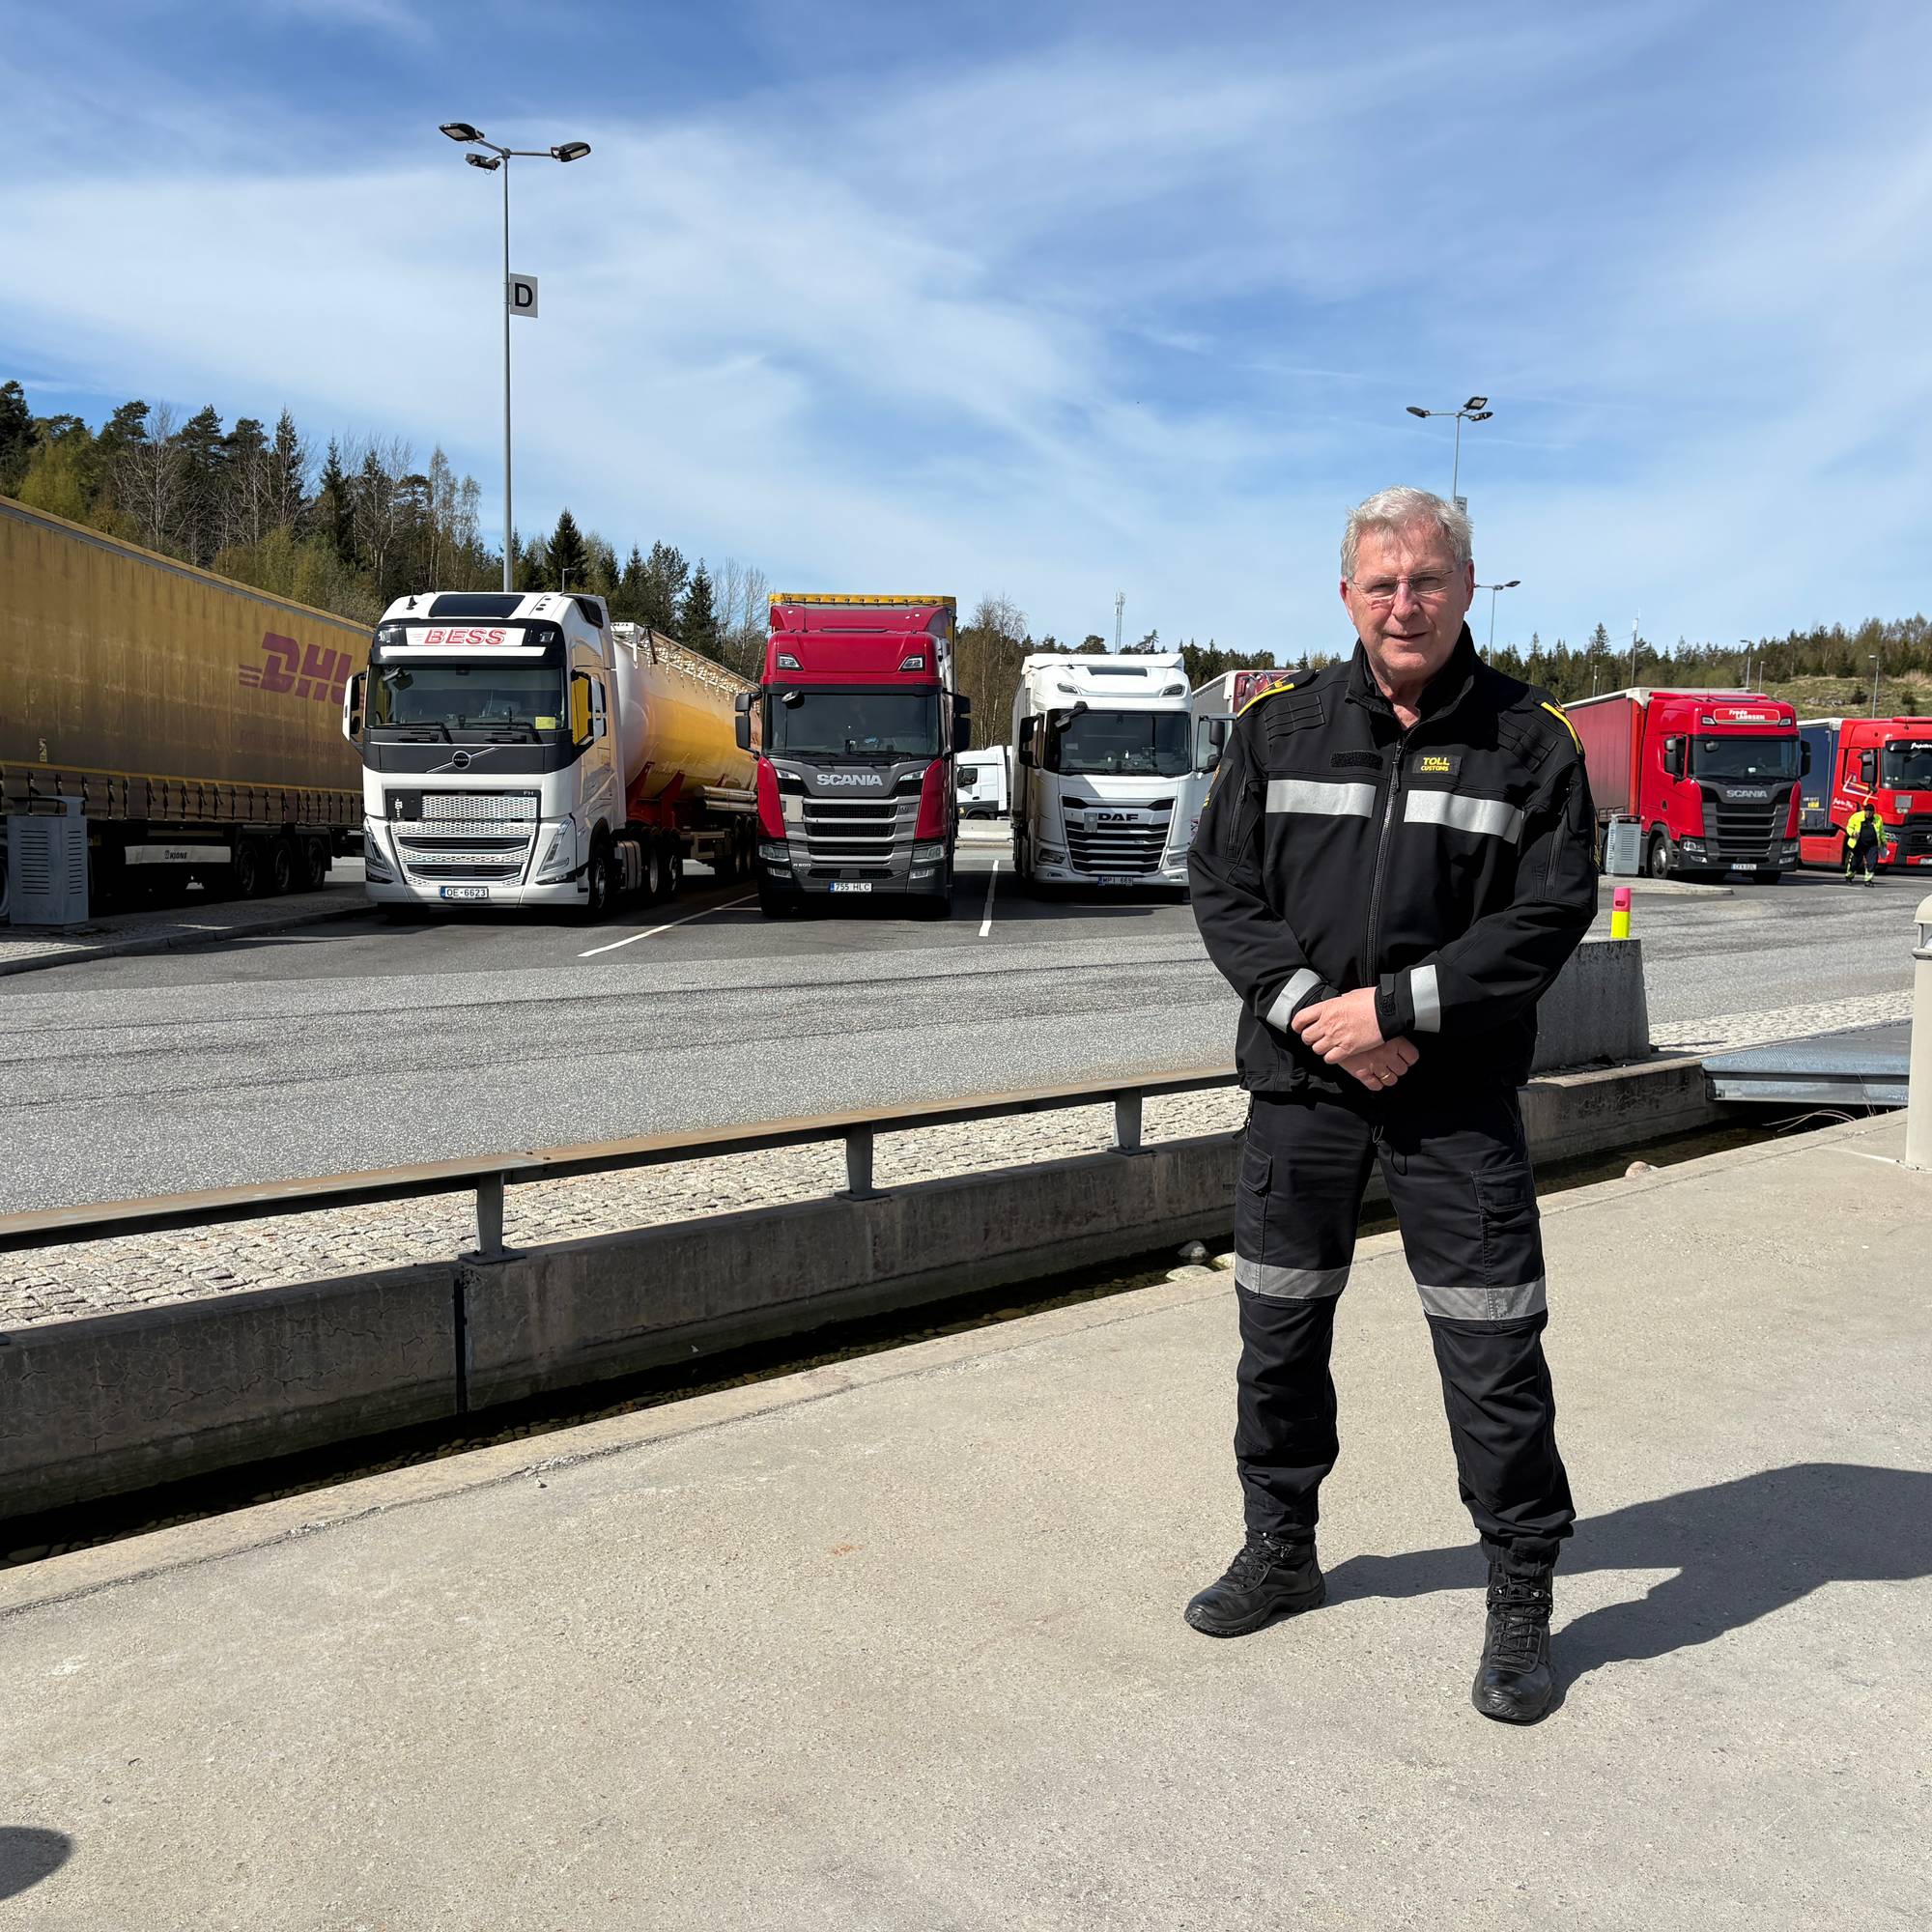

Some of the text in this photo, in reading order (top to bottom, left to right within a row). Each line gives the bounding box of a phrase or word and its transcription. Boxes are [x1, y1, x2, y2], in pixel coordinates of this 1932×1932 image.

[515, 282, 533, 308] D
[424, 628, 507, 645] BESS
[260, 631, 353, 705] DHL
[1423, 756, 1450, 766] TOLL
[816, 774, 883, 786] SCANIA
[1726, 789, 1768, 798] SCANIA
[1097, 812, 1139, 822] DAF
[446, 888, 486, 897] OE-6623
